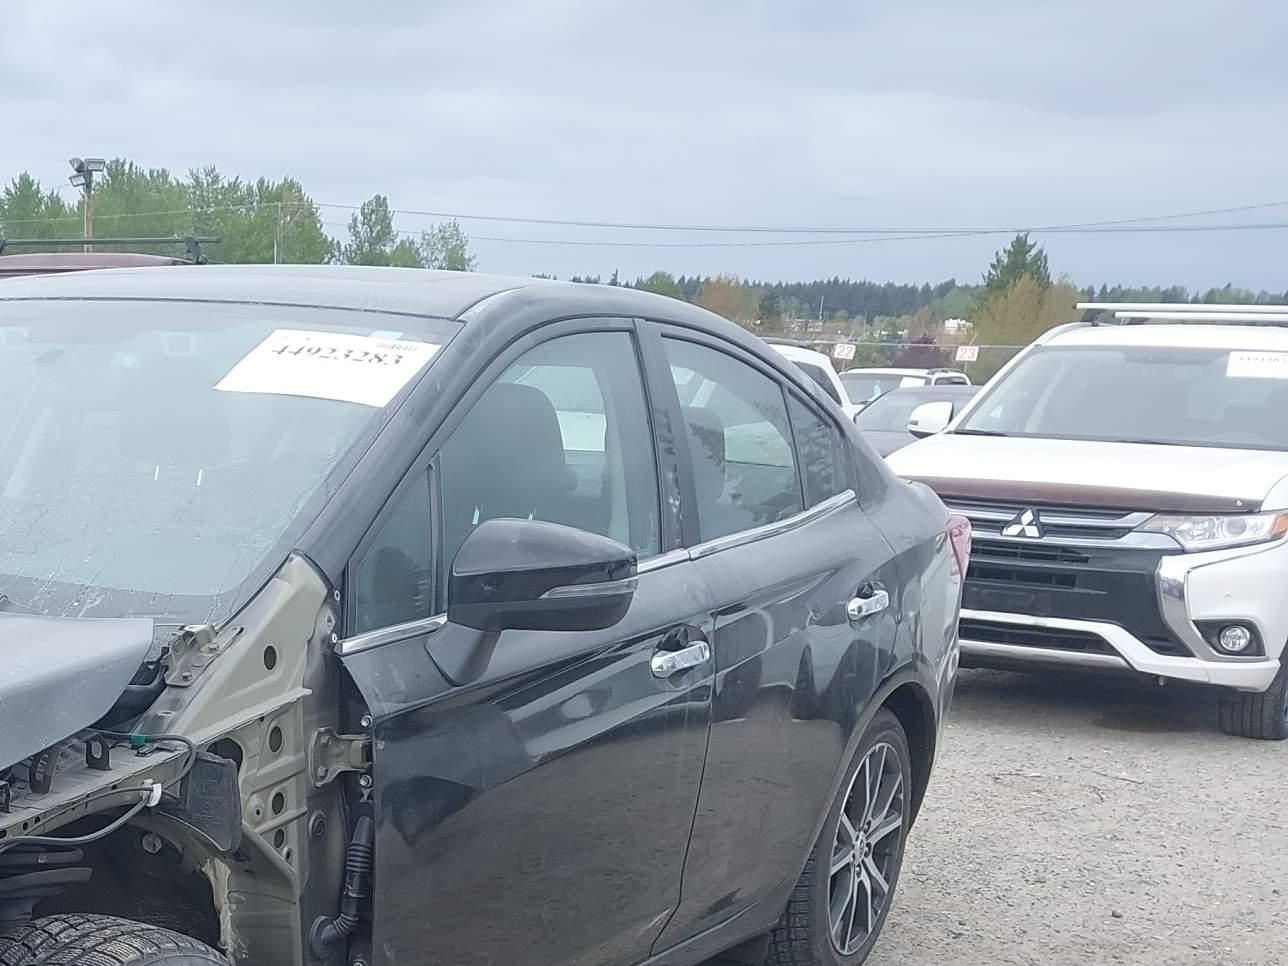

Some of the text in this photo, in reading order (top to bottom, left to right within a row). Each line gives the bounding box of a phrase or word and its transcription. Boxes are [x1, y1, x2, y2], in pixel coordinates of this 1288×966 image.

[271, 344, 404, 366] 44923283
[839, 345, 854, 357] 22
[960, 347, 976, 360] 23
